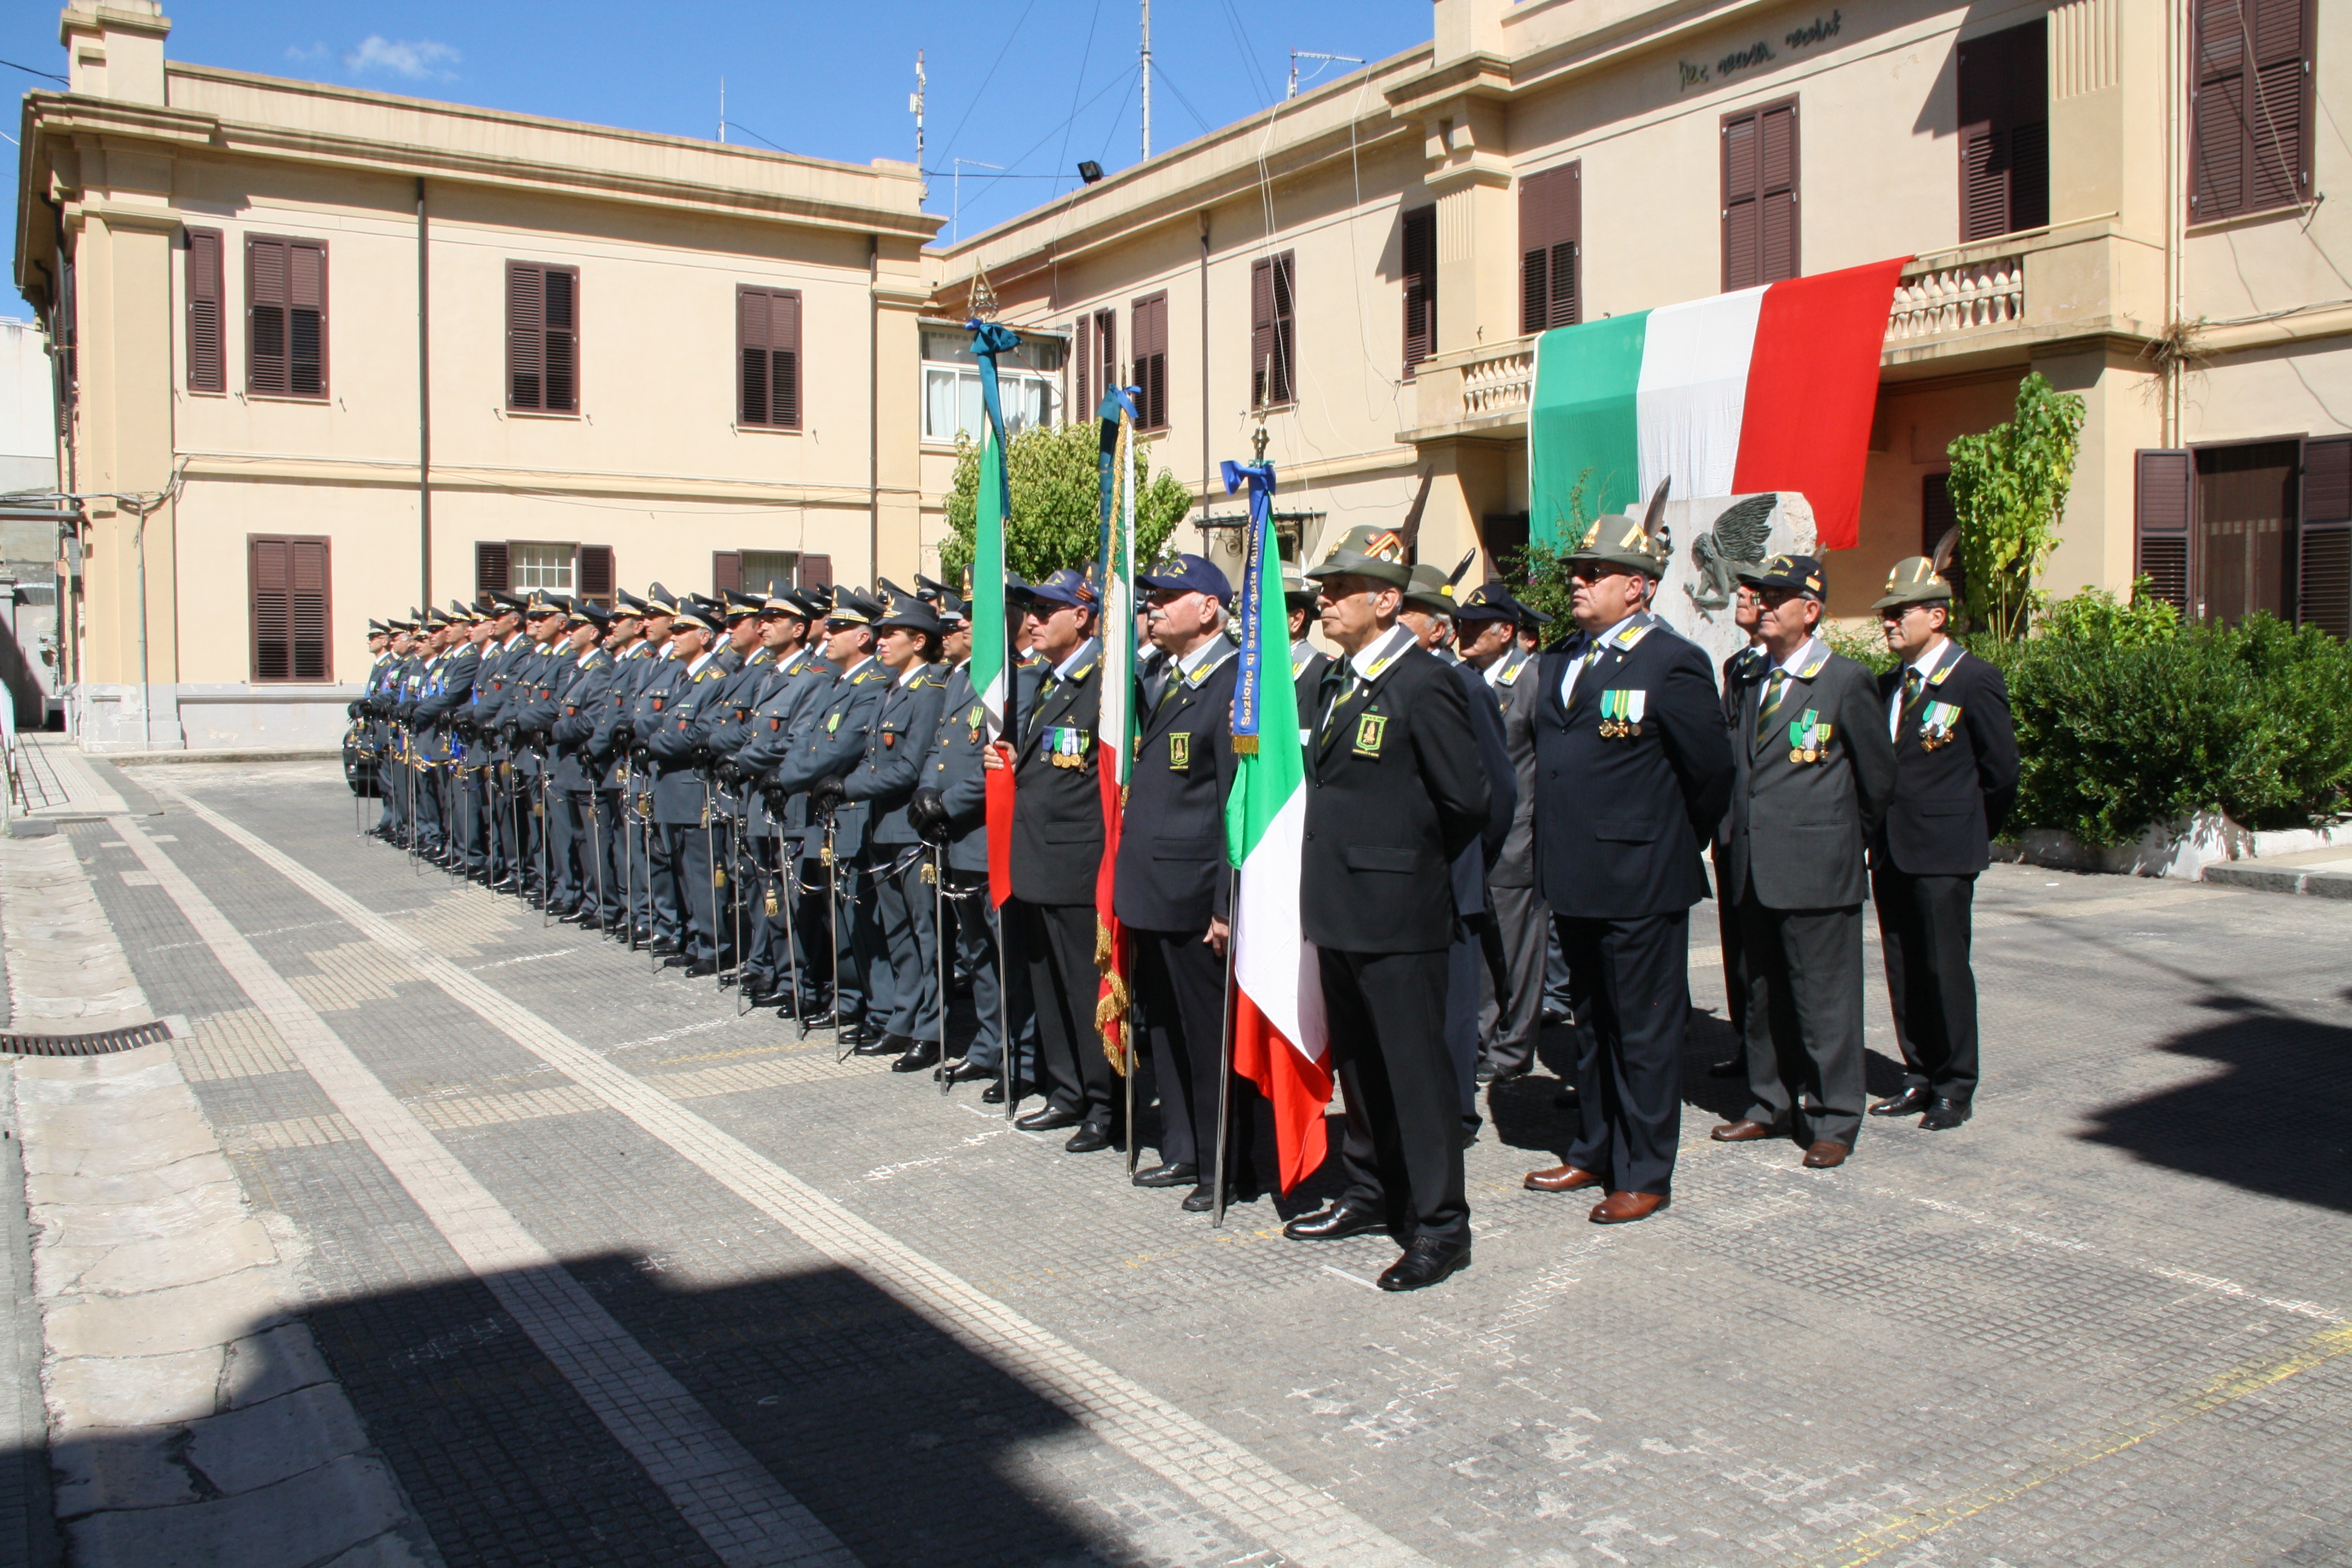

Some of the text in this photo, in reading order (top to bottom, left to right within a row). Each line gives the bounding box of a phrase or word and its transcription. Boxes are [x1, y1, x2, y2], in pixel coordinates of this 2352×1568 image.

[1247, 571, 1258, 649] Sant'Agata
[1246, 653, 1255, 666] di
[1241, 670, 1253, 725] Sezione
